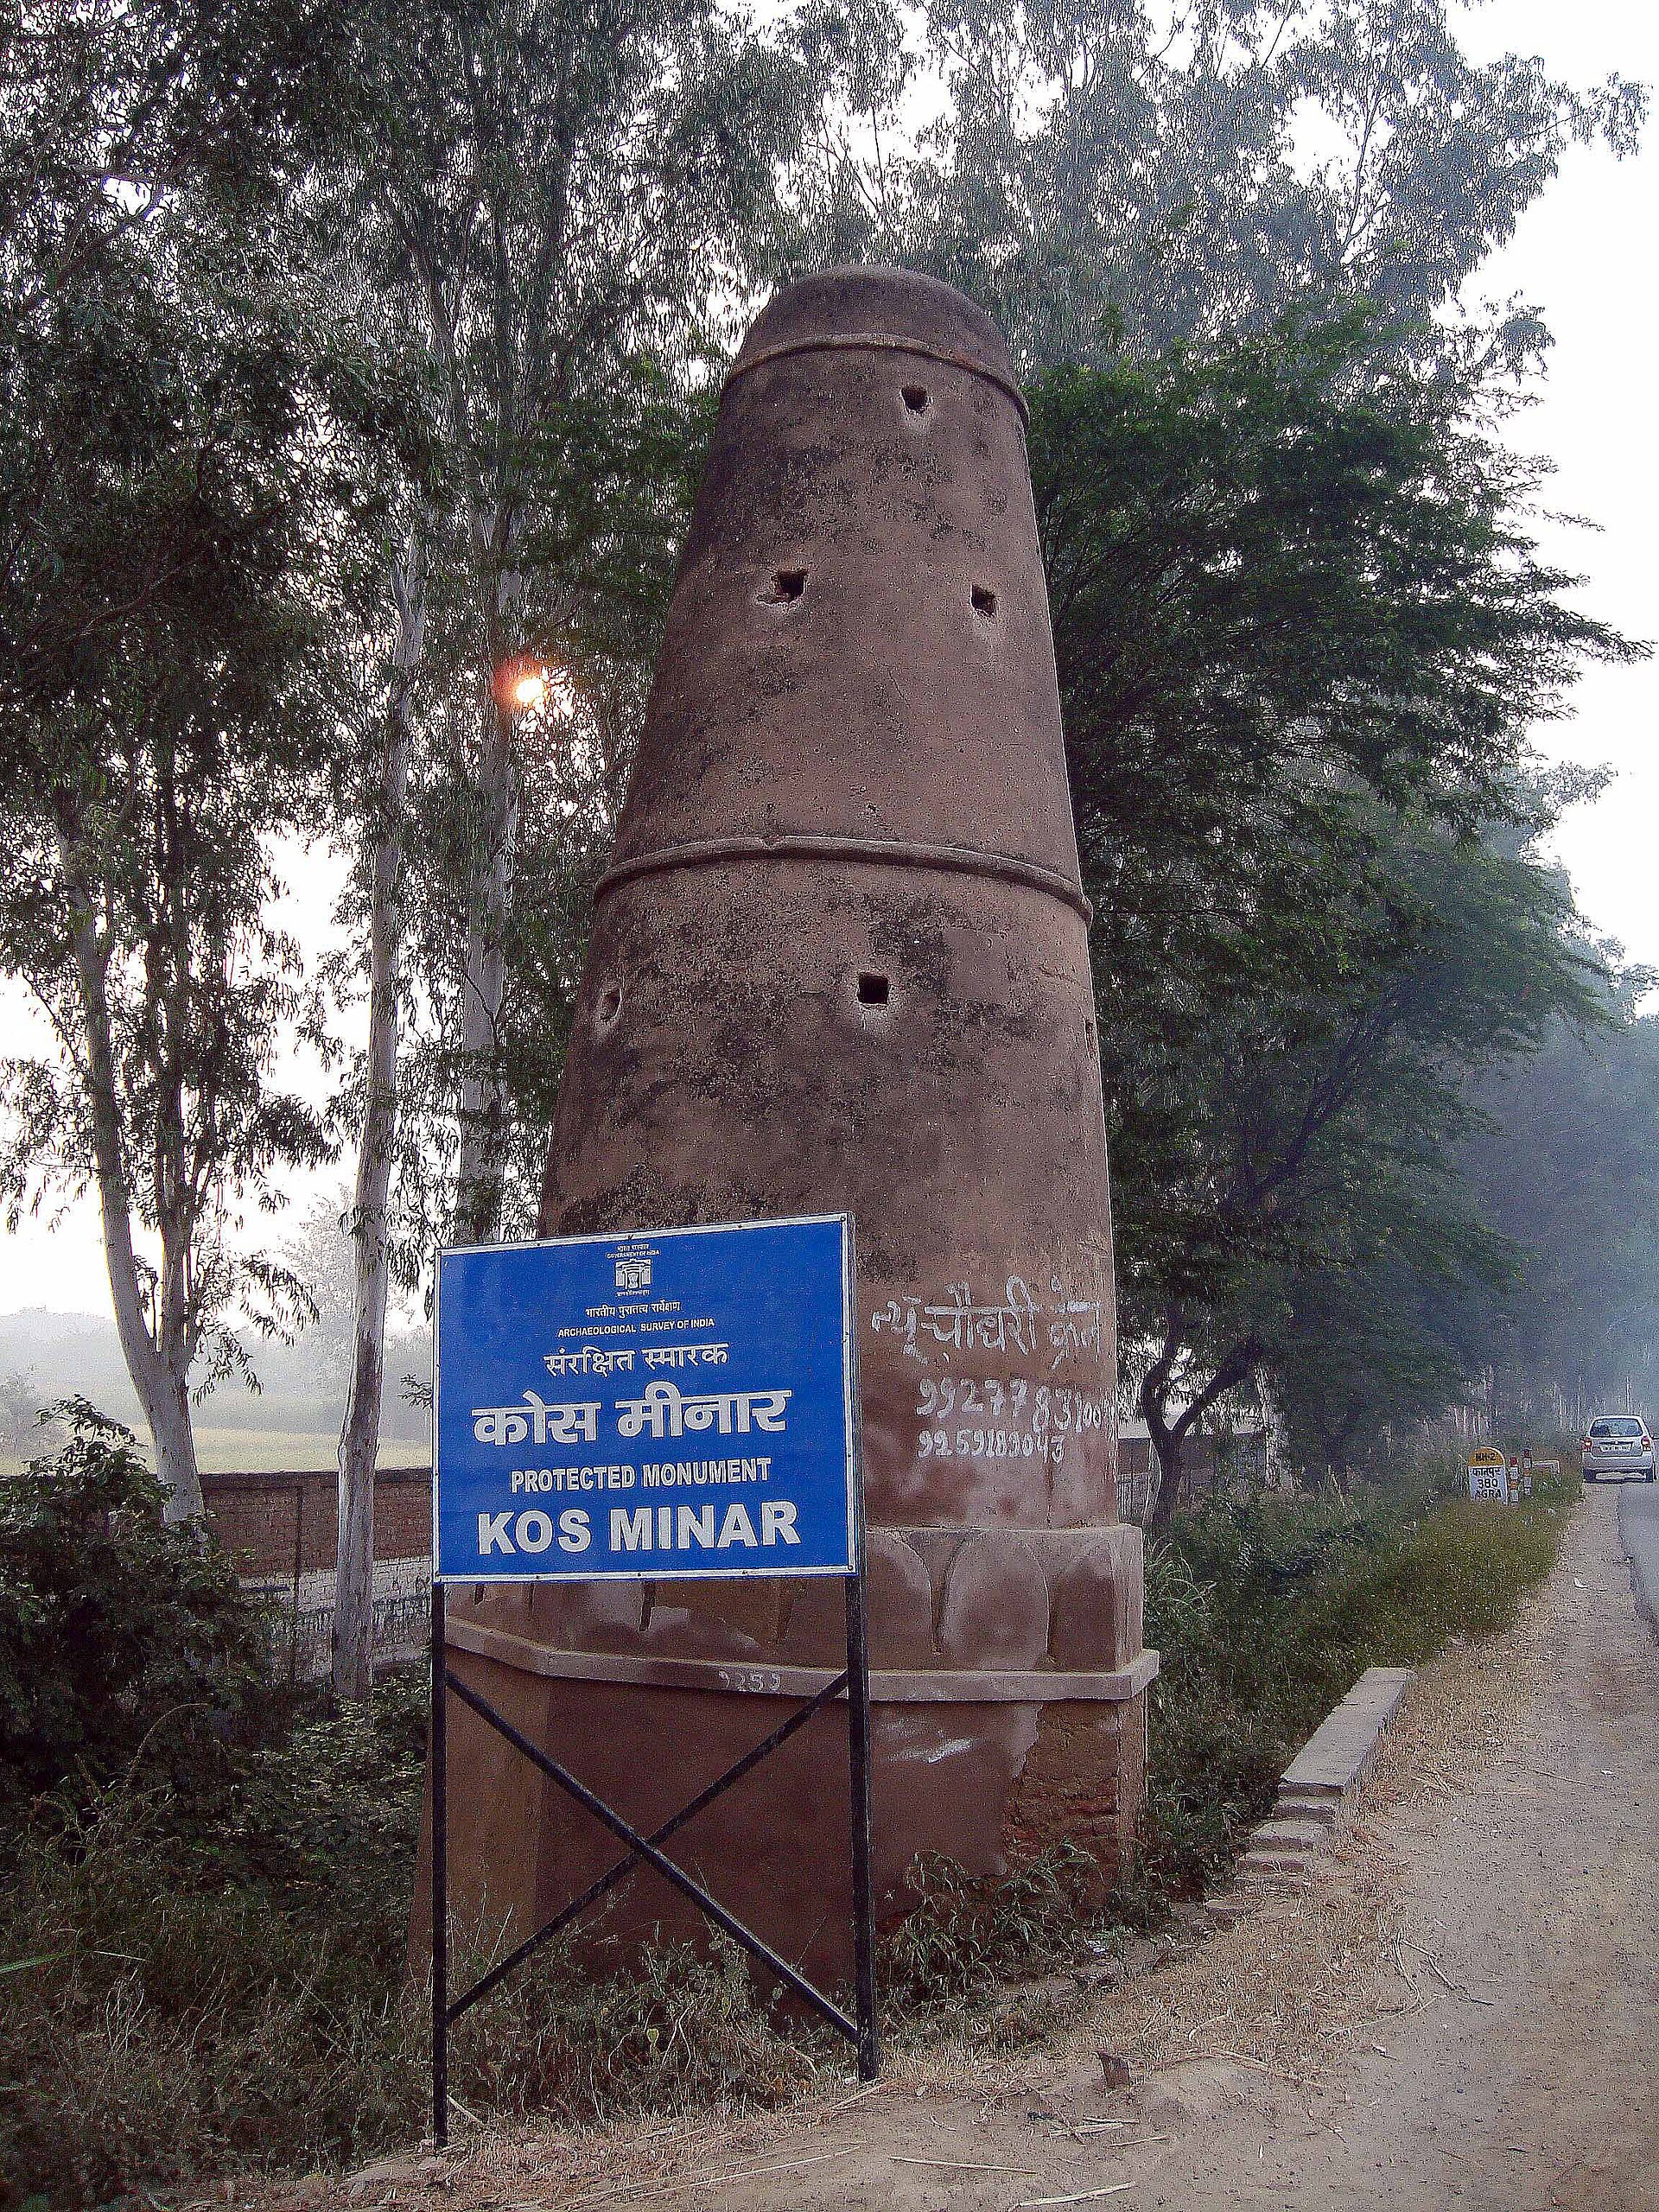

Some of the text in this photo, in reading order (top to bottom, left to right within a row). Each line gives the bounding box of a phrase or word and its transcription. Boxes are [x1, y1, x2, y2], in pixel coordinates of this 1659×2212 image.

[586, 1304, 615, 1318] भारतीय
[558, 1318, 715, 1338] ARCHAEOLOGICAL SURVEY OF INDIA
[543, 1342, 729, 1376] संरक्षित स्मारक
[472, 1380, 791, 1446] कोस मीनार
[510, 1457, 771, 1494] PROTECTED MONUMENT
[1478, 1478, 1498, 1489] 380
[1475, 1490, 1502, 1499] AGRA
[478, 1500, 802, 1556] KOS MINAR
